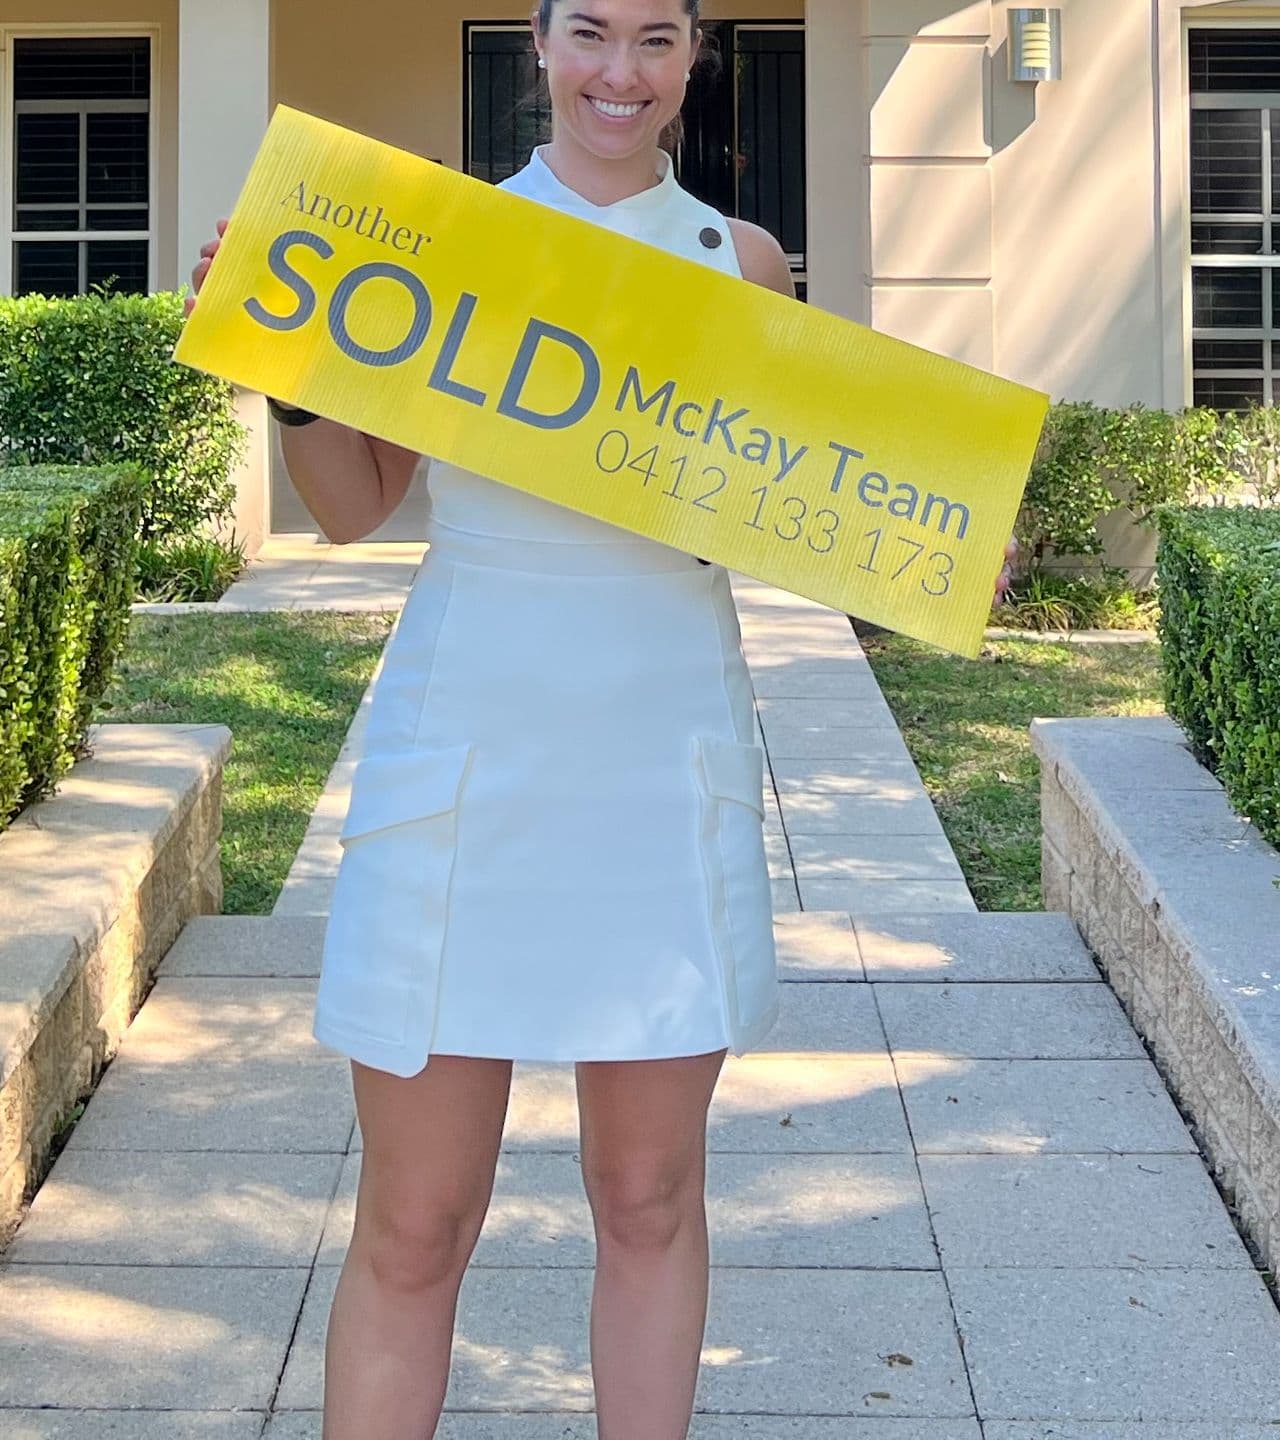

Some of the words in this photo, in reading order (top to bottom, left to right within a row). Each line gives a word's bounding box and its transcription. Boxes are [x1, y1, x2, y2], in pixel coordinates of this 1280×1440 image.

[280, 180, 433, 258] Another
[242, 229, 602, 431] SOLD
[595, 429, 728, 516] 0412
[743, 486, 839, 554] 133
[856, 528, 956, 597] 173
[614, 365, 810, 482] McKay
[827, 441, 971, 541] Team
